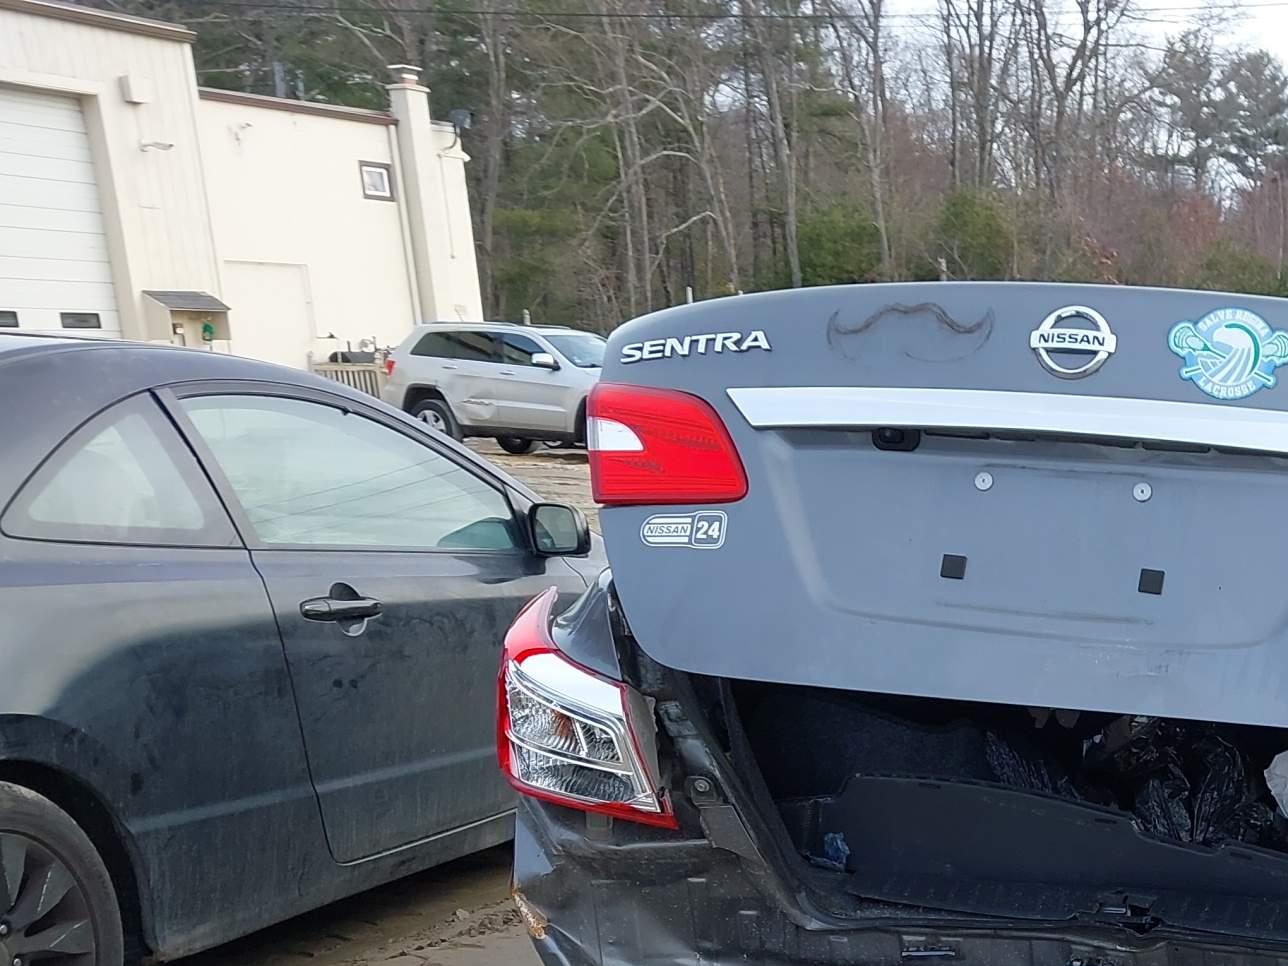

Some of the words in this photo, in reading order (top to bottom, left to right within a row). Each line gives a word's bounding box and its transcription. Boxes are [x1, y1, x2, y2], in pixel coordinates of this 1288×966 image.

[1234, 310, 1270, 337] REA
[620, 329, 772, 364] SENTRA
[1038, 332, 1105, 347] NISSAN
[1198, 376, 1257, 399] LACROSSE
[646, 525, 689, 535] NISSAN
[695, 520, 720, 539] 24
